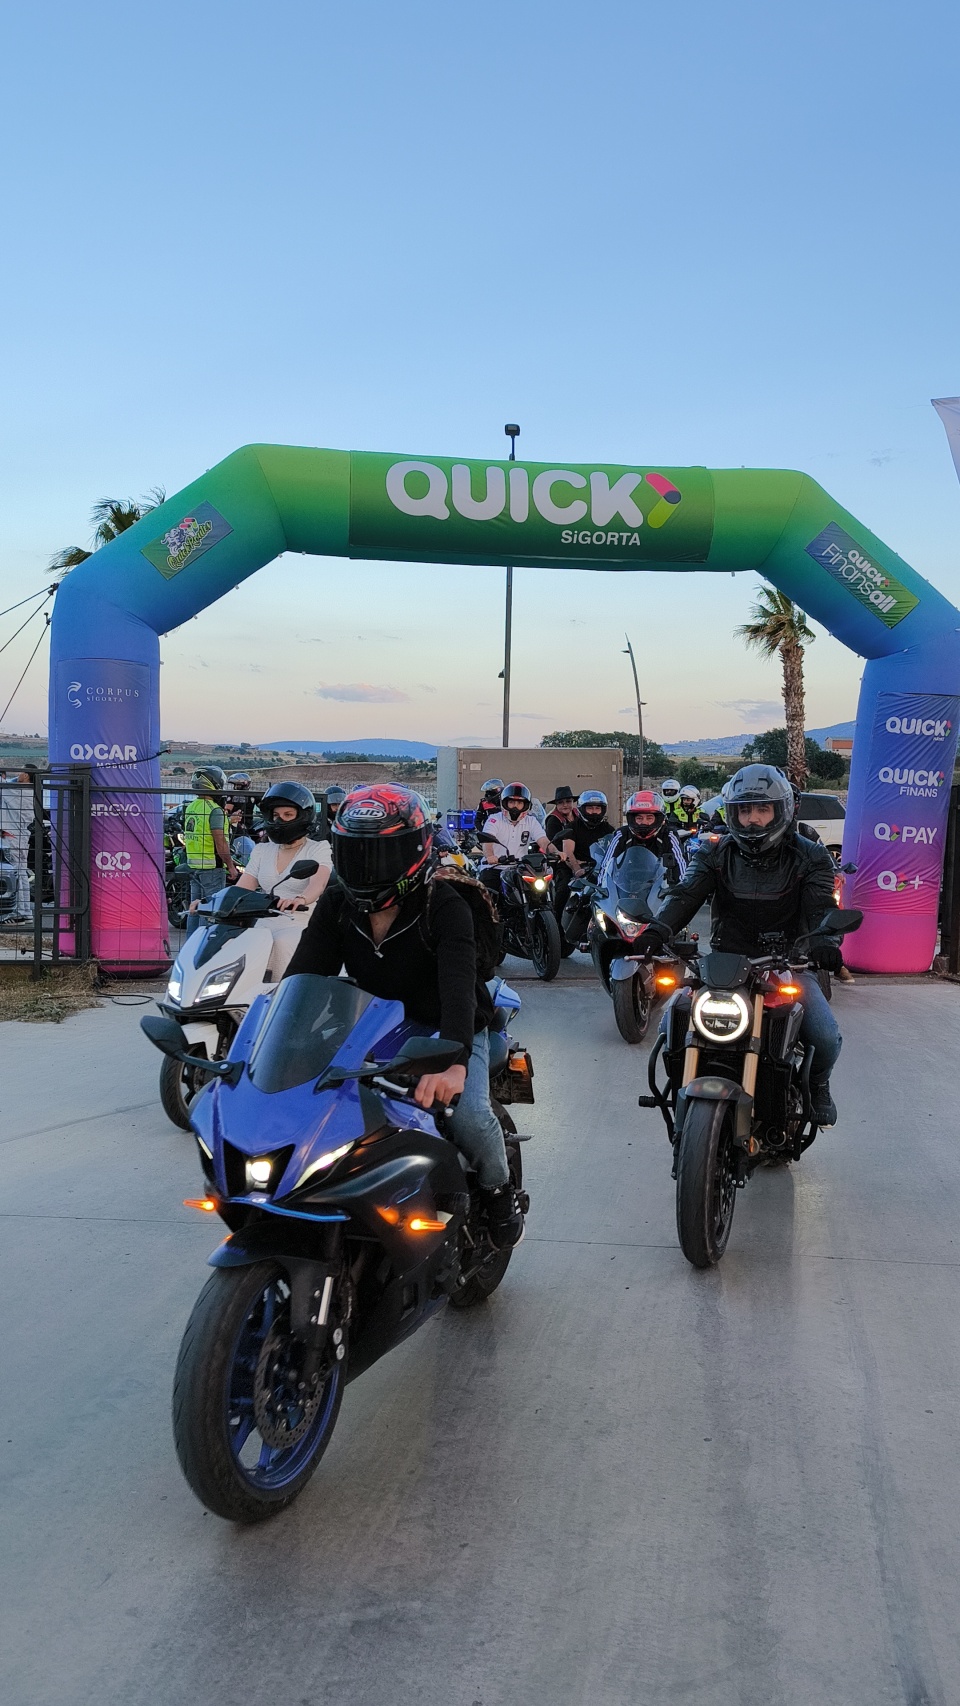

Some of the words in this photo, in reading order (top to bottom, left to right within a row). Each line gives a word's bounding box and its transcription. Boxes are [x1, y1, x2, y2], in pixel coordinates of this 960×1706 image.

[385, 460, 644, 528] QUICK
[847, 549, 886, 586] QUICK
[86, 686, 140, 698] CORPUS
[885, 716, 948, 737] QUICK
[878, 766, 940, 787] QUICK
[352, 809, 381, 817] HJC
